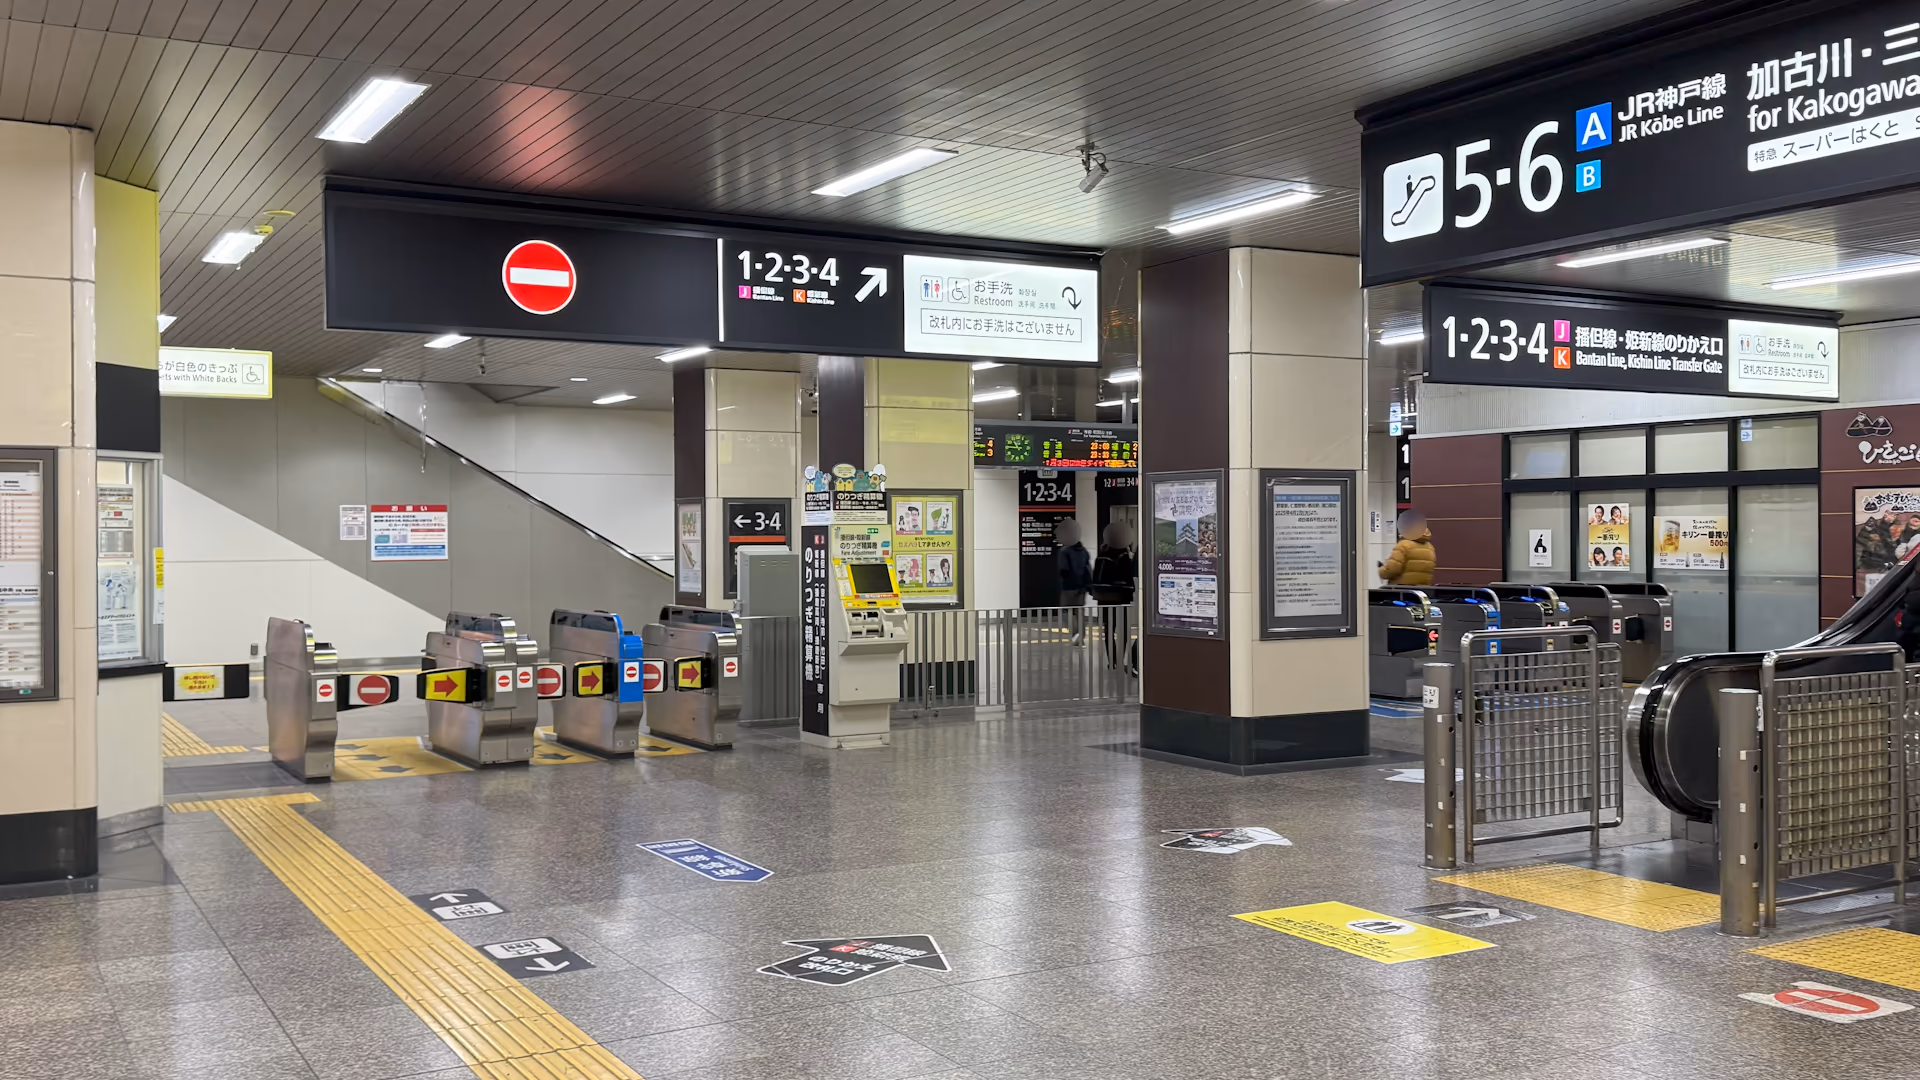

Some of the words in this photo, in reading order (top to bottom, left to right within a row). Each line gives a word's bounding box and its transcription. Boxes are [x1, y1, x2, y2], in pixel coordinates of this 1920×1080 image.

[1618, 73, 1727, 122] JR神戸線
[1747, 104, 1782, 132] for
[1788, 74, 1920, 124] Kakogawa
[1582, 111, 1607, 145] A
[1619, 124, 1638, 142] JR
[1640, 114, 1684, 137] Kōbe
[1687, 104, 1725, 126] Line
[1754, 147, 1778, 163] 特急
[1783, 119, 1900, 159] スーパーはくと
[1582, 166, 1596, 188] B
[974, 280, 1013, 296] お手洗
[974, 296, 1013, 307] Restroom
[929, 315, 1075, 336] 改札内にお手洗はございません
[1558, 323, 1565, 339] J
[1575, 326, 1724, 356] 播但線・姫新線のりかえ口
[1768, 337, 1791, 350] お手洗
[1558, 350, 1567, 366] K
[1576, 350, 1607, 367] Bantan
[1608, 352, 1627, 370] Line,
[1628, 354, 1653, 370] Kishin
[1654, 355, 1671, 371] Line
[1672, 356, 1702, 373] Transfer
[1703, 358, 1723, 374] Gate
[1768, 350, 1790, 358] Restroom
[193, 374, 215, 383] White
[217, 375, 238, 383] Backs
[1743, 364, 1825, 379] 改札内にお手洗はございません
[988, 448, 994, 457] 3
[1682, 531, 1729, 539] キリン一番搾り
